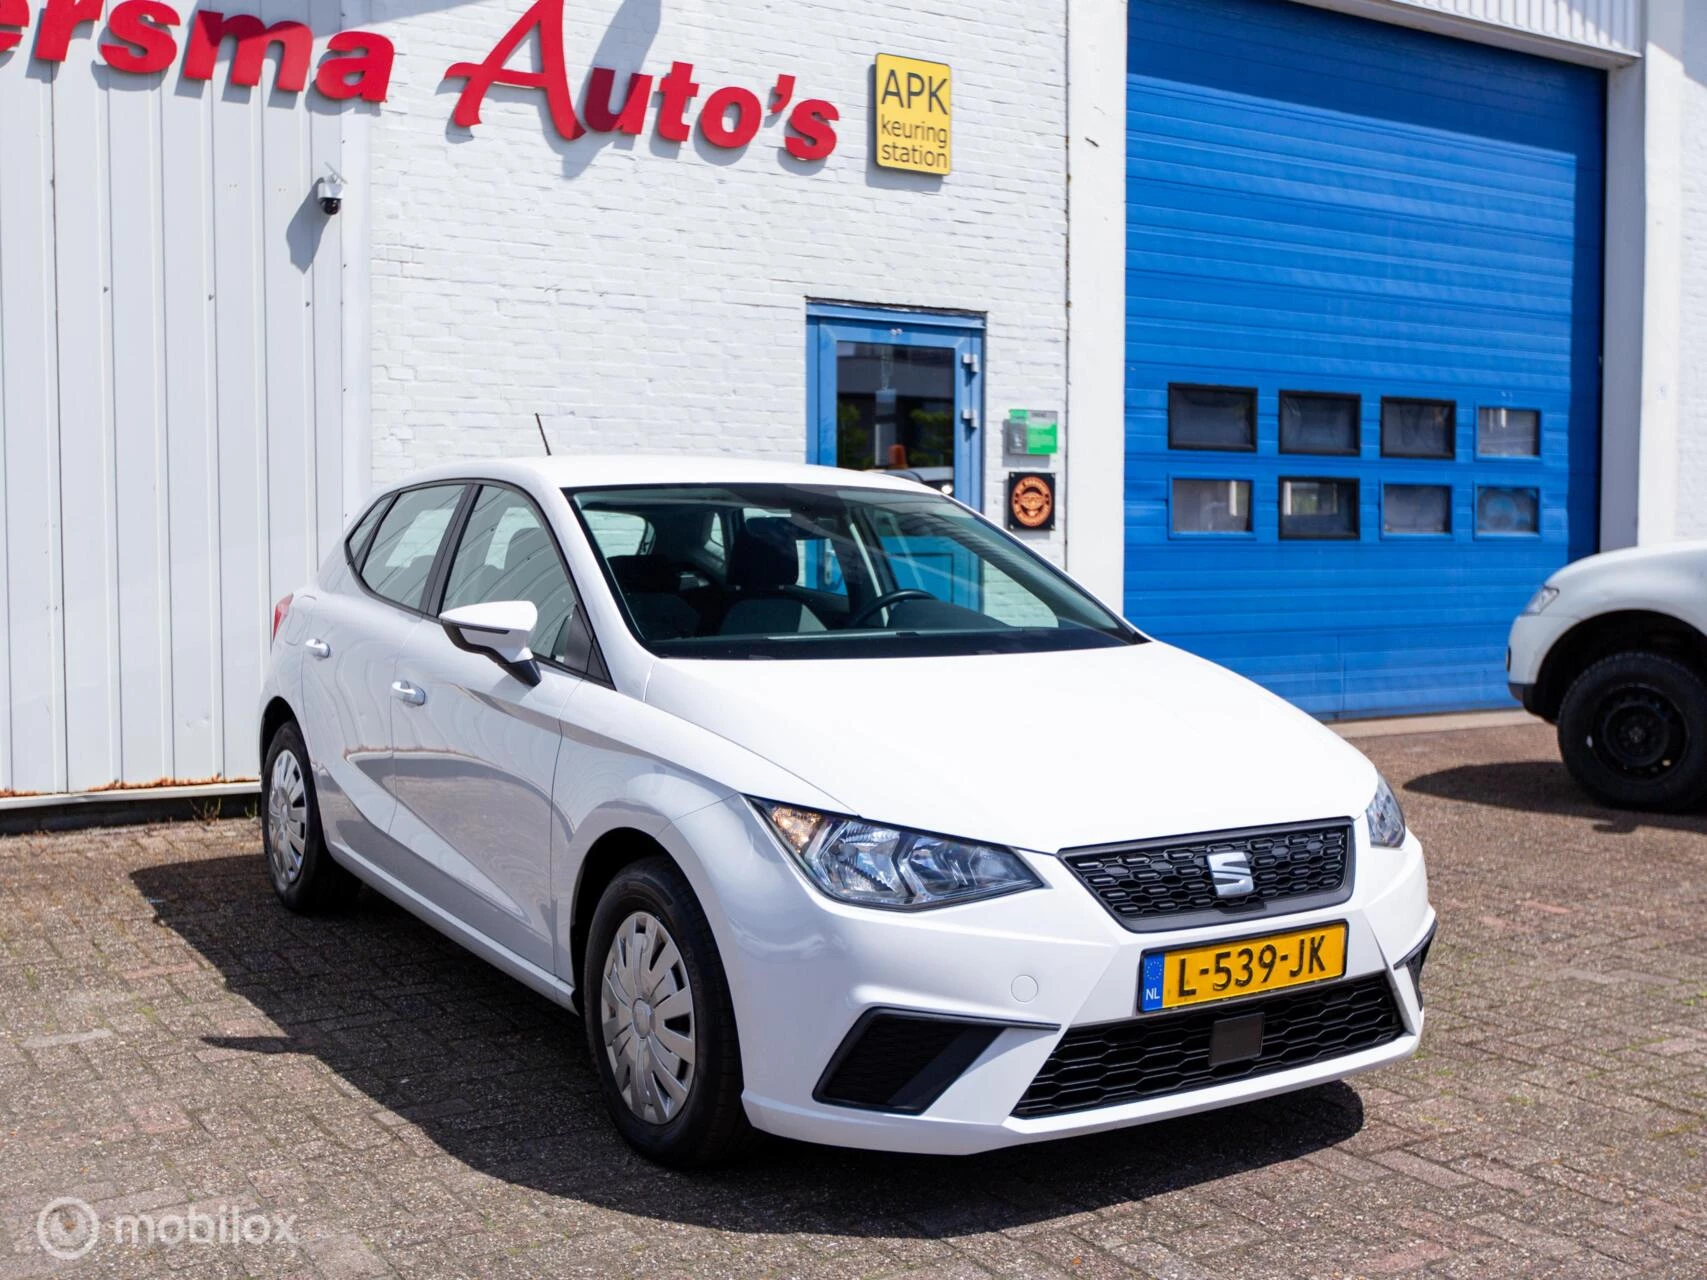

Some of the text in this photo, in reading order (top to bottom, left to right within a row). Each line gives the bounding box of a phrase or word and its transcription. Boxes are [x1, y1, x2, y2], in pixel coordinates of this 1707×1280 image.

[444, 0, 840, 161] Auto's
[881, 69, 948, 115] APK
[881, 114, 948, 149] keuring
[881, 143, 948, 168] station
[1178, 935, 1326, 998] L-539-JK
[1145, 987, 1161, 1000] NL
